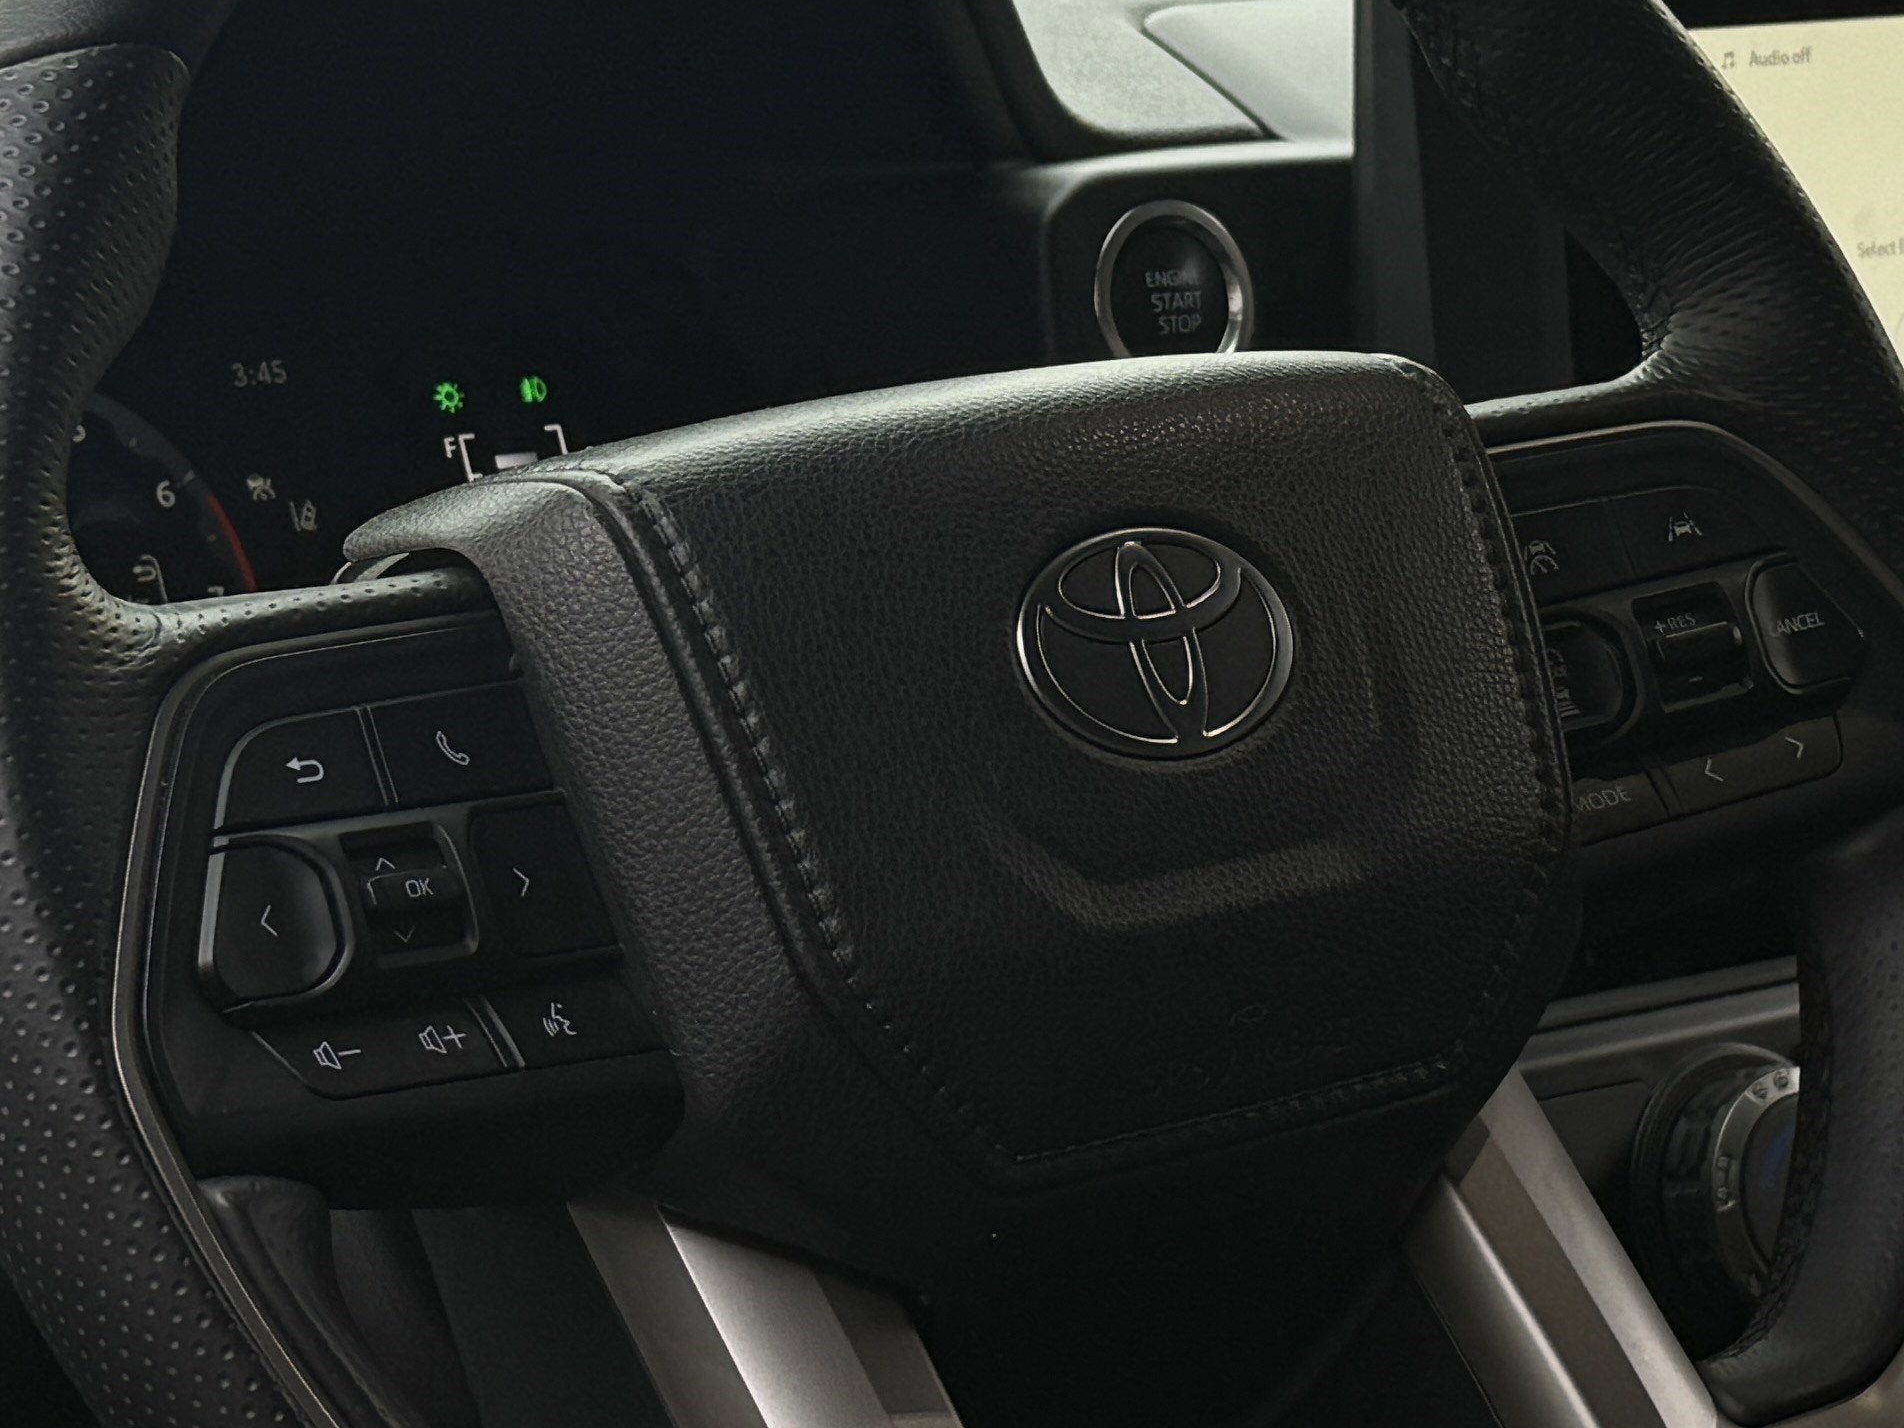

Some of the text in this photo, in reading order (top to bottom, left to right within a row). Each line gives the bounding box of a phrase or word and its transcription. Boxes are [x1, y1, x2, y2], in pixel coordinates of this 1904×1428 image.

[1749, 46, 1812, 67] Audio off
[1151, 290, 1202, 312] START
[1158, 313, 1202, 335] STOP
[232, 359, 288, 389] 3:45
[156, 478, 177, 509] 6
[405, 876, 433, 898] OK
